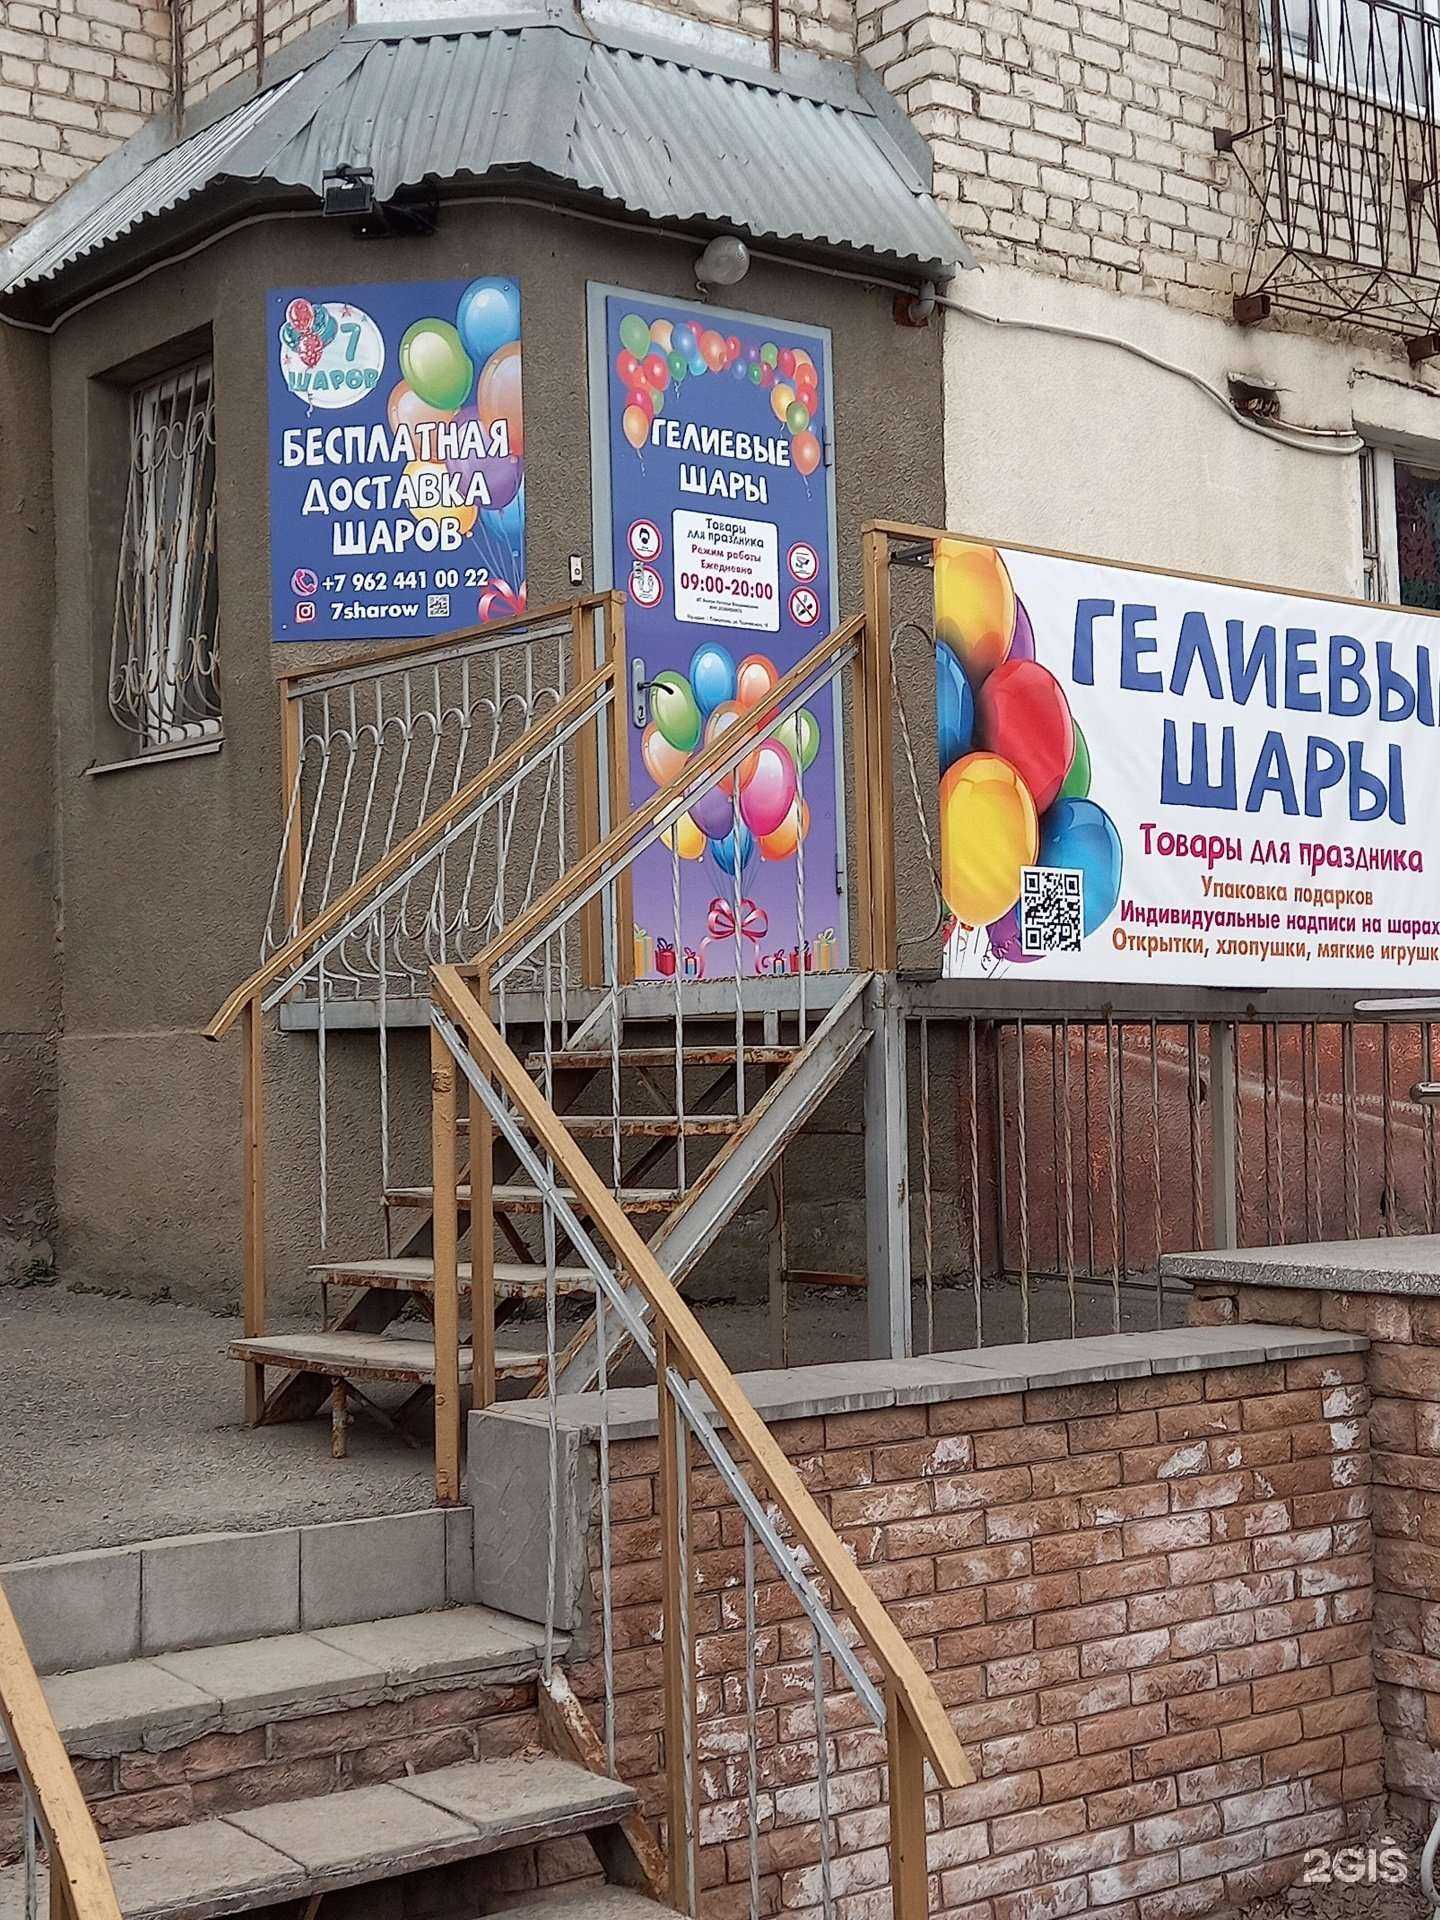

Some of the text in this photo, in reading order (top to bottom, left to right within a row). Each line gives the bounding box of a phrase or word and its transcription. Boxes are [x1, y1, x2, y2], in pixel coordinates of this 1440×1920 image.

[340, 322, 361, 361] 7
[282, 419, 510, 467] БЕСПЛАТНАЯ
[651, 418, 791, 467] ГЕЛИЕВЫЕ
[302, 471, 492, 515] ДОСТАВКА
[679, 463, 769, 504] ШАРЫ
[332, 517, 464, 556] ШАРОВ
[705, 518, 746, 536] Товары
[708, 532, 764, 548] праздника
[691, 544, 761, 562] Режим работы
[322, 568, 489, 592] +7 962 441 00 22
[681, 572, 773, 600] 09:00-20:00
[330, 602, 419, 620] 7sharow
[1072, 598, 1440, 729] ГЕЛИЕВЫ
[1160, 718, 1406, 825] ШАРЫ
[1139, 823, 1424, 876] Товары для праздника
[1201, 875, 1374, 910] Упаковка подарков
[1120, 900, 1281, 932] Индивидуальные
[1286, 913, 1356, 934] надписи
[1362, 917, 1382, 933] на
[1112, 927, 1210, 959] Открытки,
[1216, 938, 1312, 961] хлопушки,
[1317, 942, 1375, 959] мягкие
